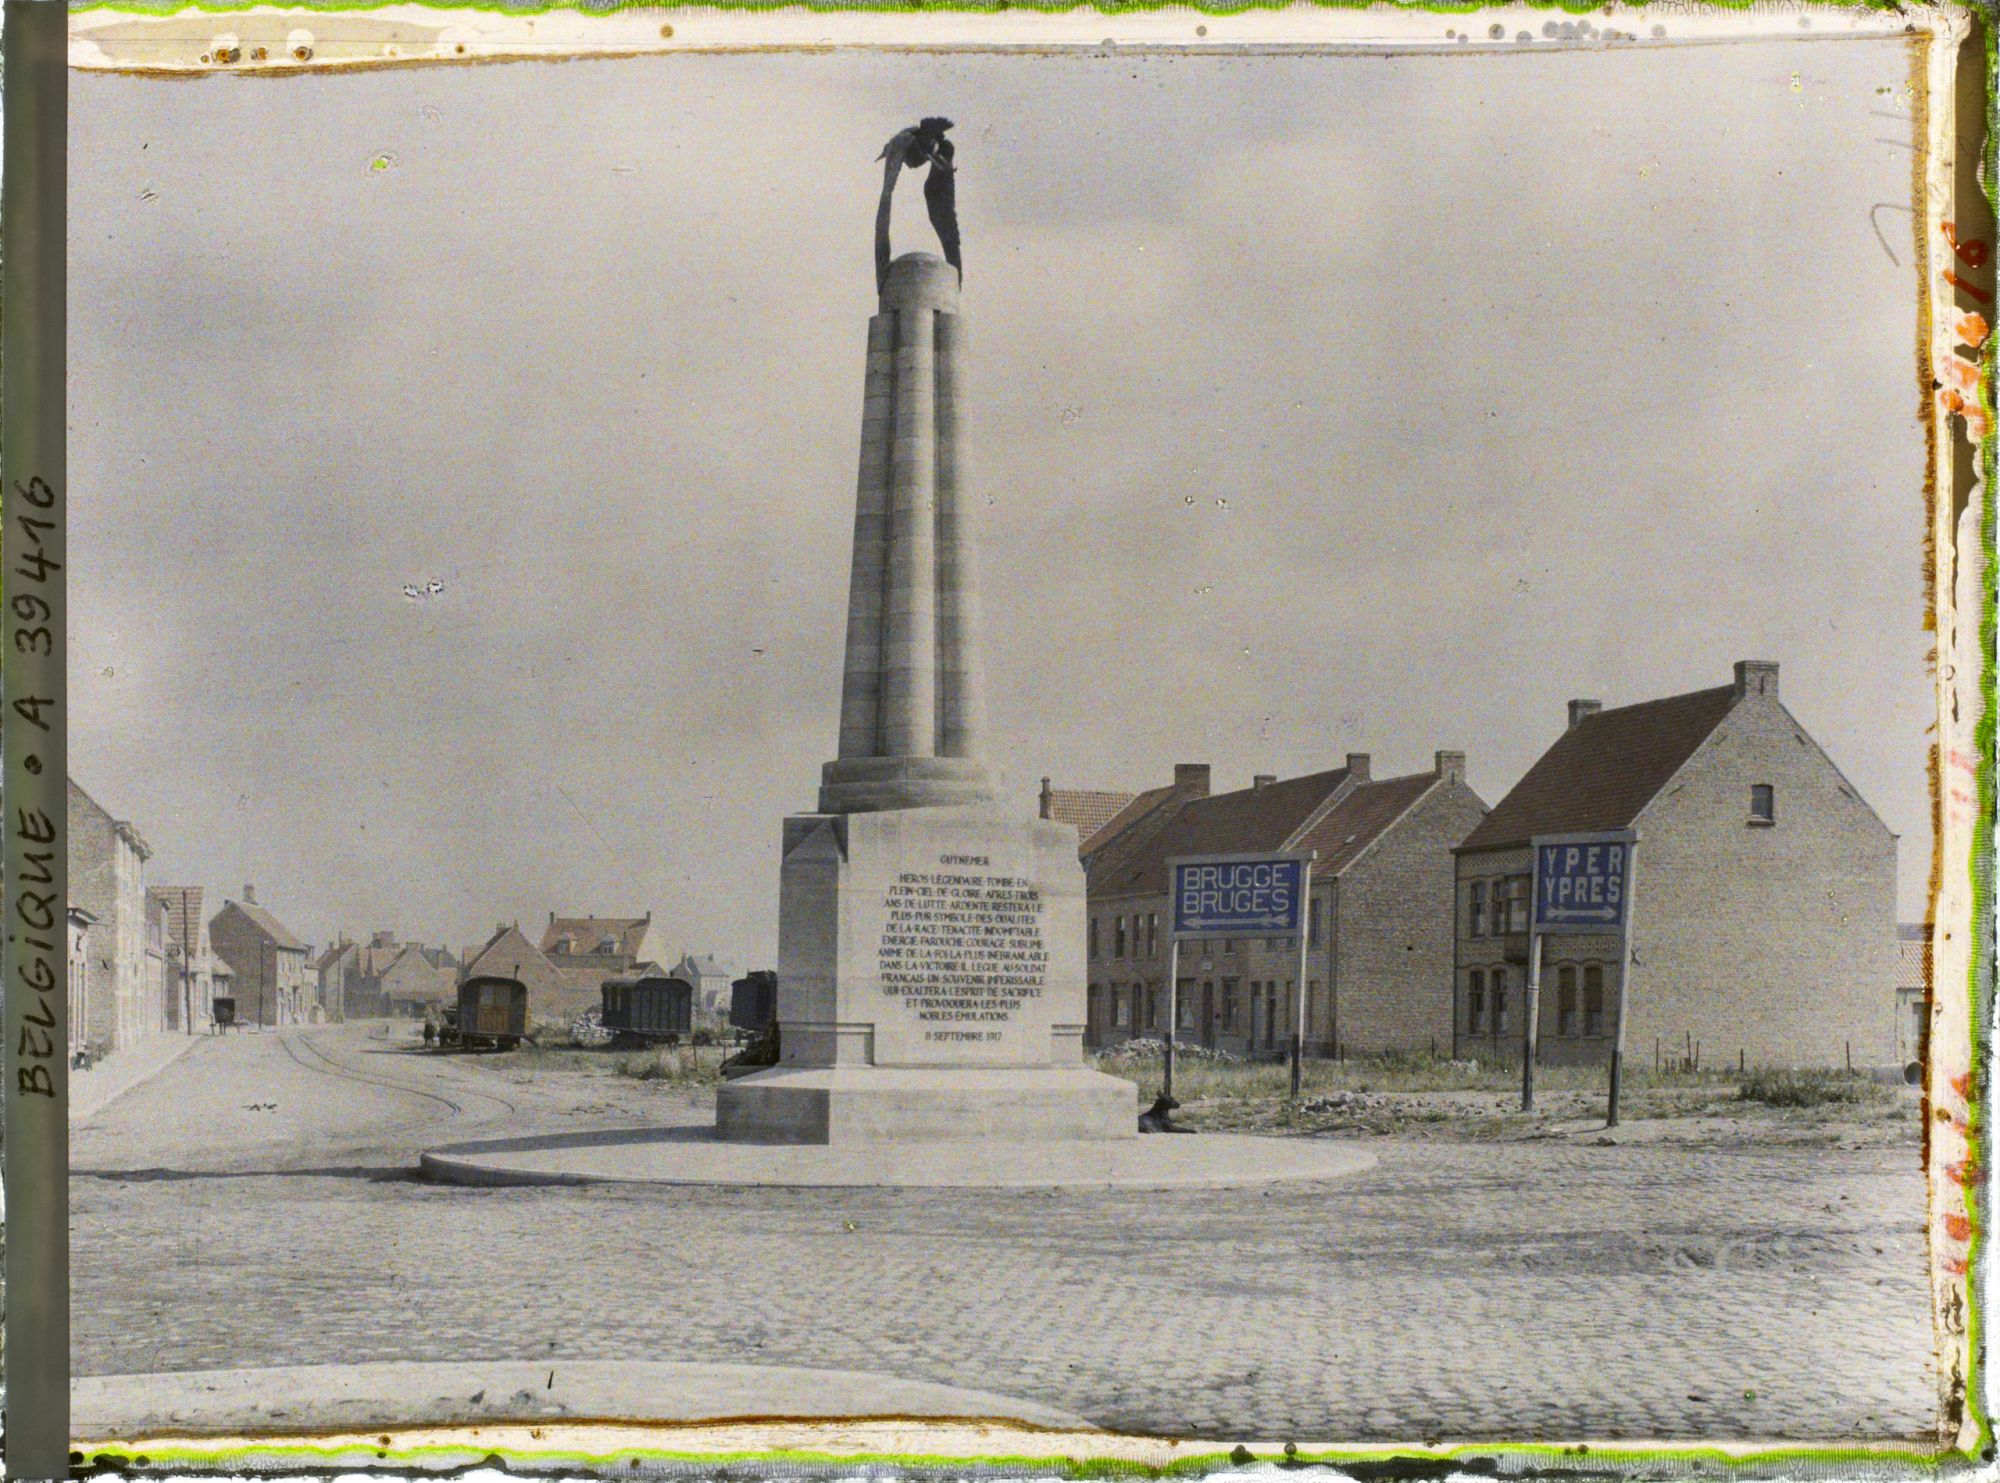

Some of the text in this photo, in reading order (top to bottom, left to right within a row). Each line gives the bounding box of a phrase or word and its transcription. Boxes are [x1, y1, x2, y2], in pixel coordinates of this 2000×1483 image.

[11, 475, 62, 657] 39416
[12, 694, 55, 732] A
[940, 854, 990, 866] GUYNEMER
[1545, 845, 1623, 875] YPER
[1017, 878, 1028, 888] EN
[1182, 863, 1291, 890] BRUGGE
[889, 885, 913, 895] PLEIN
[916, 887, 934, 896] CIEL
[937, 887, 948, 897] DE
[952, 888, 981, 898] GLOIRE
[1015, 890, 1039, 901] TROIS
[1545, 876, 1623, 904] YPRES
[884, 898, 1043, 913] ANS DE LUTTE ARDENTE RESTERA LE
[1182, 889, 1290, 915] BRUGES
[891, 910, 912, 921] PLUS
[915, 911, 931, 921] PUR
[934, 912, 973, 923] SYMBOLE
[976, 913, 993, 923] DES
[886, 923, 897, 933] DE
[900, 923, 912, 933] LA
[915, 924, 937, 934] RACE
[984, 926, 1040, 937] INDOMPTABLE
[920, 936, 963, 947] FAROUCHE
[966, 937, 1006, 948] COURAGE
[1009, 939, 1044, 949] SUBLIME
[906, 948, 916, 958] DE
[920, 948, 931, 958] LA
[934, 949, 948, 959] FOI
[950, 949, 962, 959] LA
[964, 950, 985, 960] PLUS
[879, 960, 902, 970] DANS
[905, 961, 918, 971] LA
[920, 961, 959, 972] VICTOIRE
[961, 962, 967, 972] IL
[1003, 963, 1014, 973] AU
[1015, 963, 1046, 974] SOLDAT
[927, 973, 939, 983] UN
[942, 973, 986, 985] SOUVENIR
[883, 985, 898, 996] QUI
[901, 985, 947, 996] EXALTERA
[987, 987, 998, 997] DE
[1001, 987, 1042, 998] SACRIFICE
[906, 998, 1021, 1010] ET PROVOQUERA LES PLUS
[919, 1011, 953, 1021] NOBLES
[933, 1031, 983, 1042] SEPTEMBRE
[986, 1031, 1002, 1042] 1917
